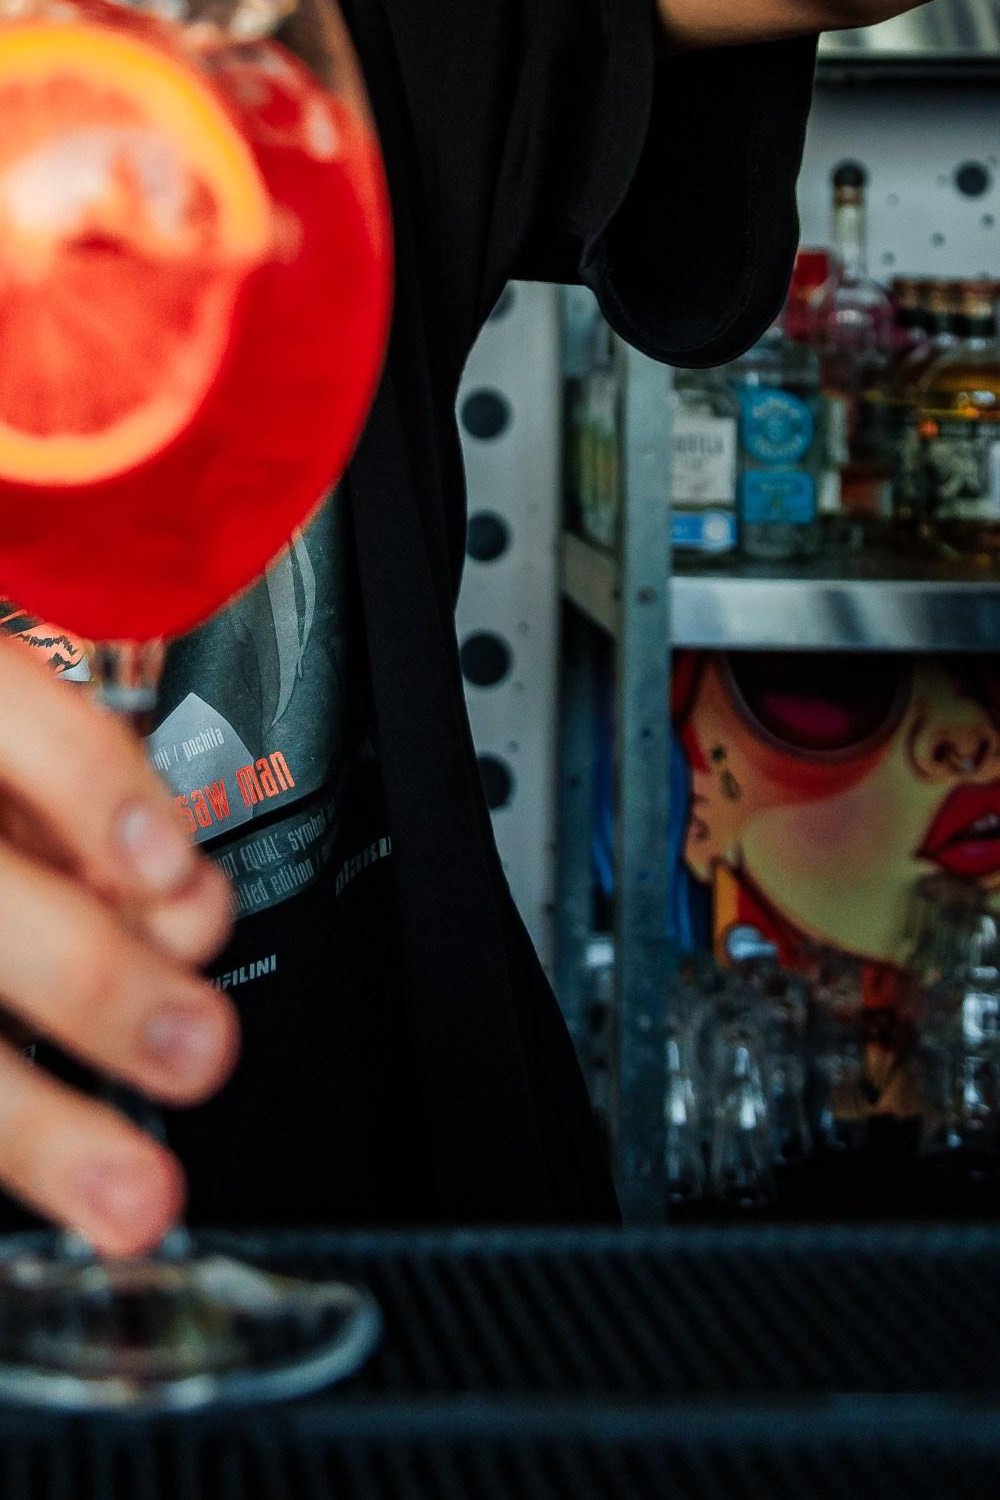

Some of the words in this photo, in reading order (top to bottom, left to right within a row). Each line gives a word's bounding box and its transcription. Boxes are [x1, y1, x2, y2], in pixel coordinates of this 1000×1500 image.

[181, 726, 225, 762] pochita
[235, 750, 296, 809] man
[270, 858, 316, 896] edition
